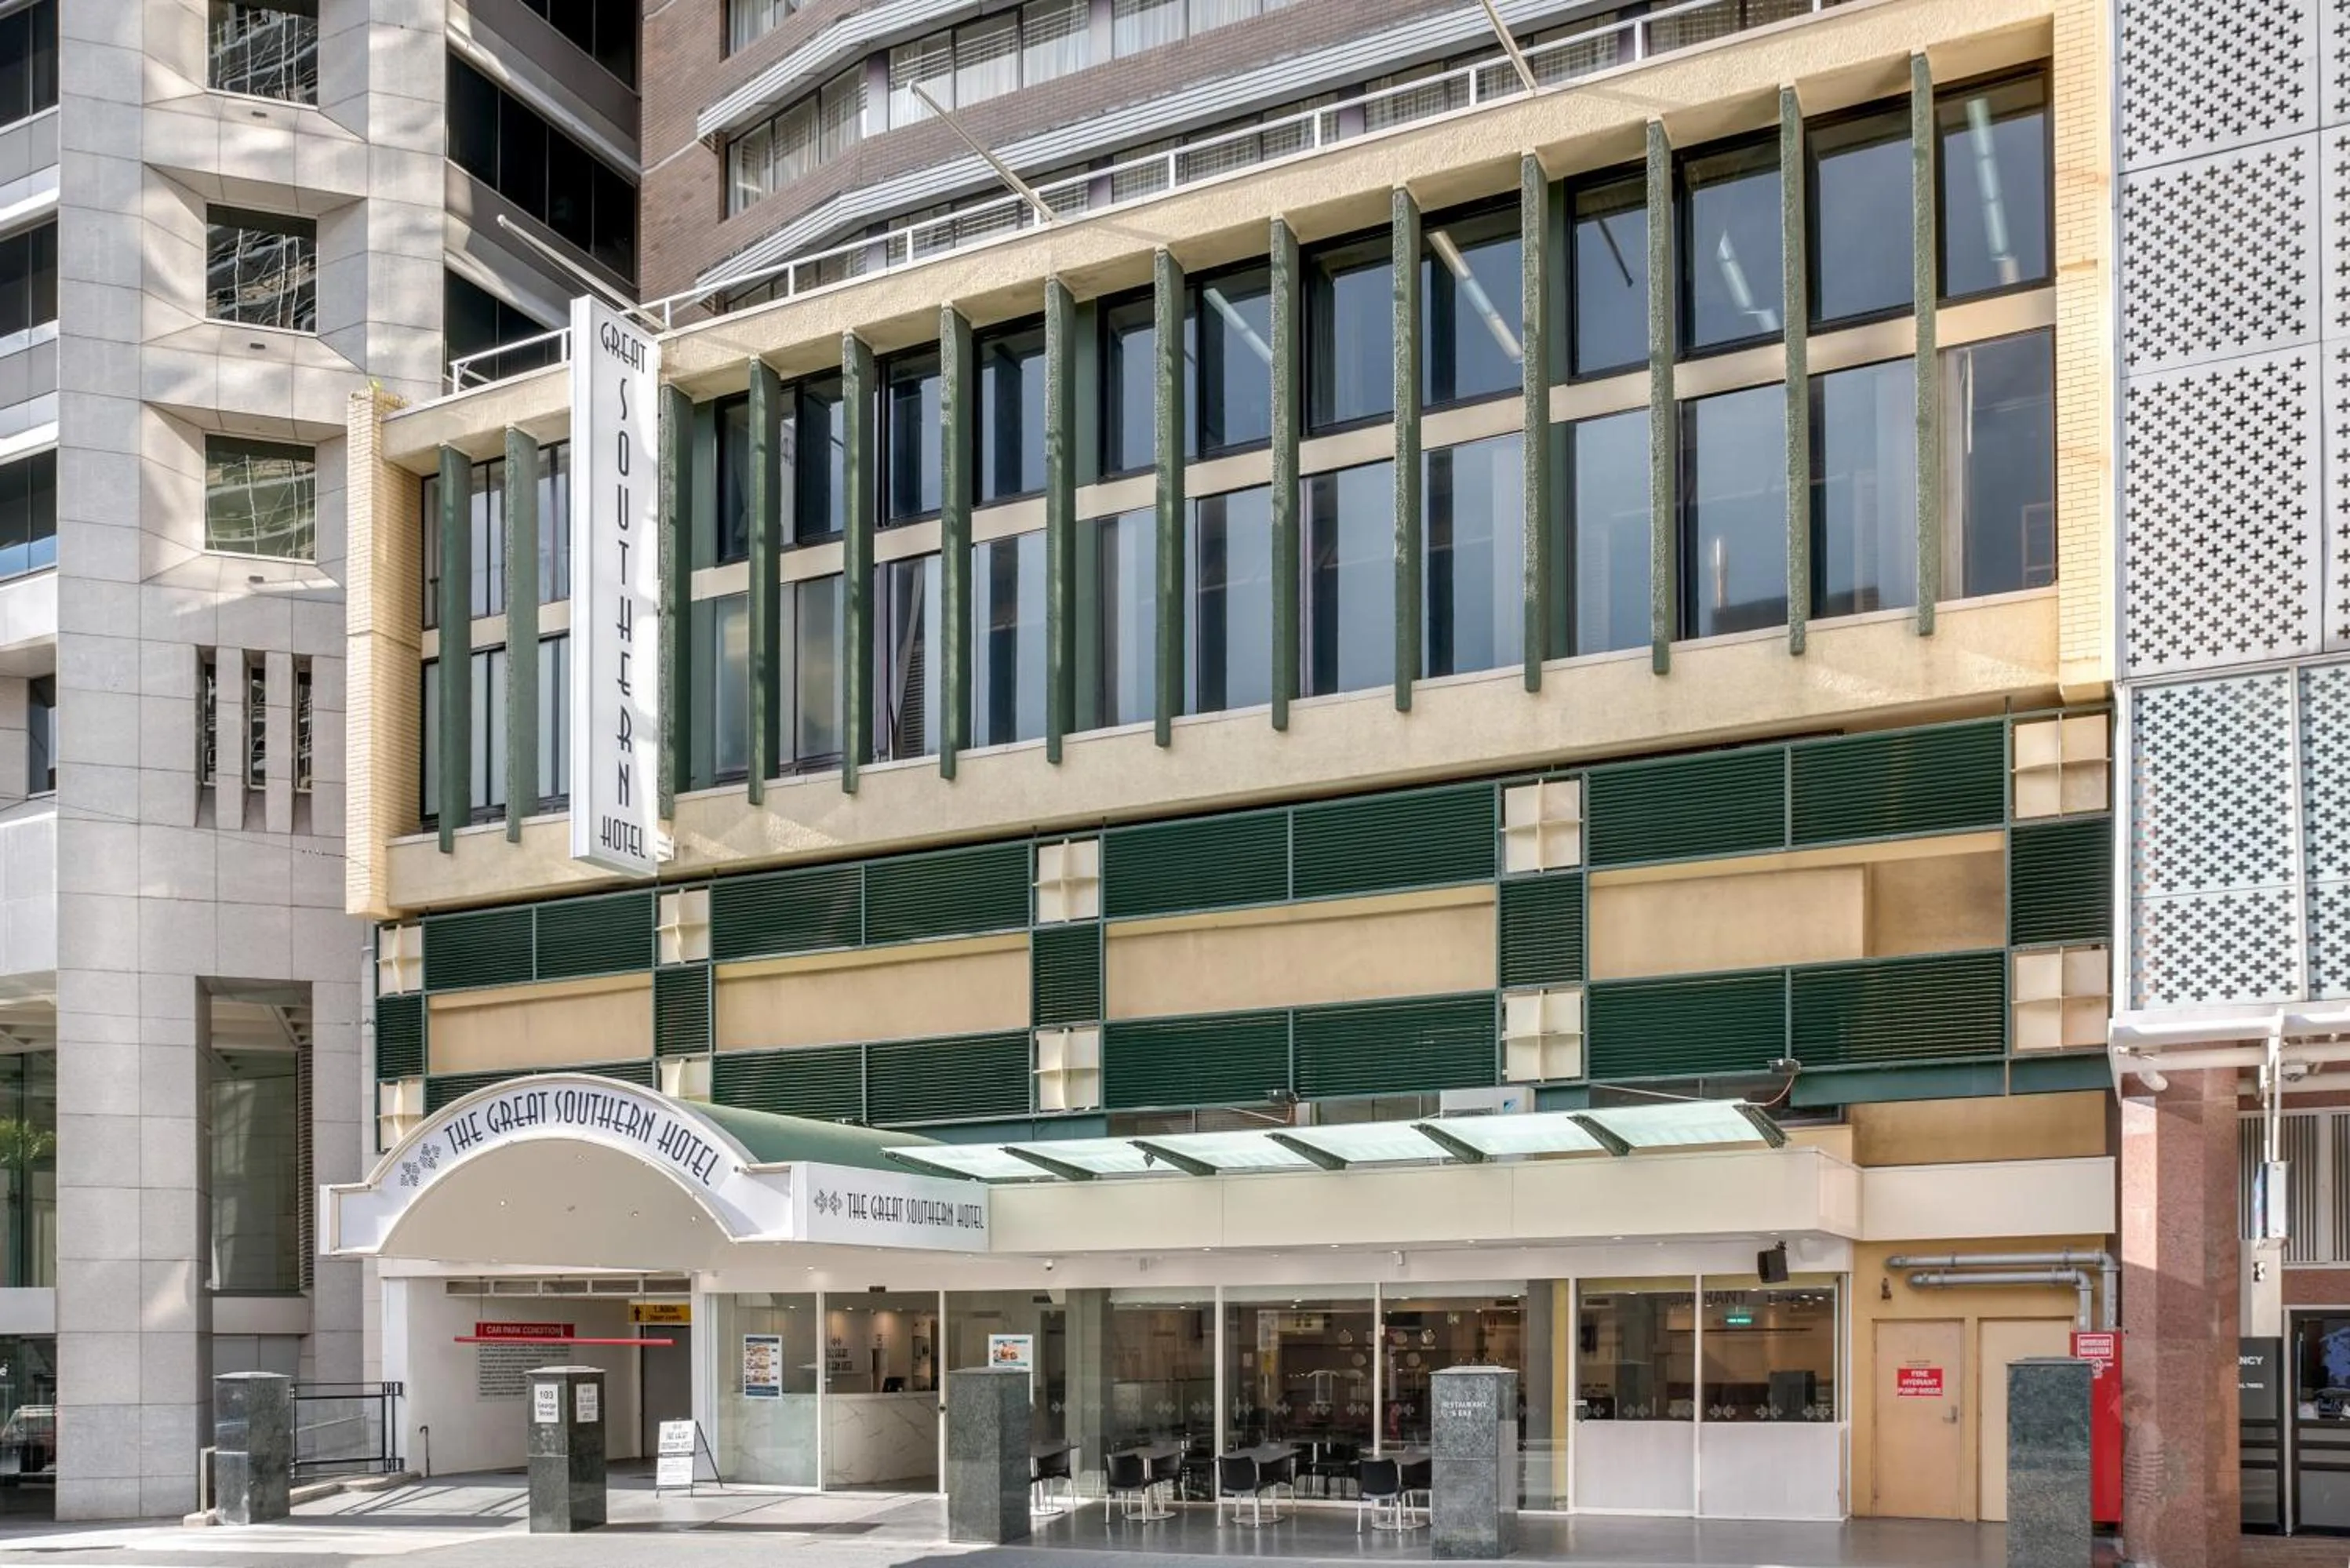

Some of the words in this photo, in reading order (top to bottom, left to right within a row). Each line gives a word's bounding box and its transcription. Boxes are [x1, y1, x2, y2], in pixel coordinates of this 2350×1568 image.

[601, 322, 646, 373] GREAT
[617, 377, 632, 808] SOUTHERN
[600, 815, 646, 859] HOTEL
[443, 1111, 482, 1155] THE
[487, 1091, 549, 1135] GREAT
[555, 1090, 657, 1144] SOUTHERN
[657, 1119, 719, 1187] HOTEL
[847, 1192, 867, 1220] THE
[871, 1195, 903, 1223] GREAT
[907, 1198, 954, 1227] SOUTHERN
[957, 1203, 984, 1229] HOTEL
[486, 1326, 502, 1334] CAR
[503, 1326, 521, 1334] PARK
[540, 1390, 554, 1399] 103
